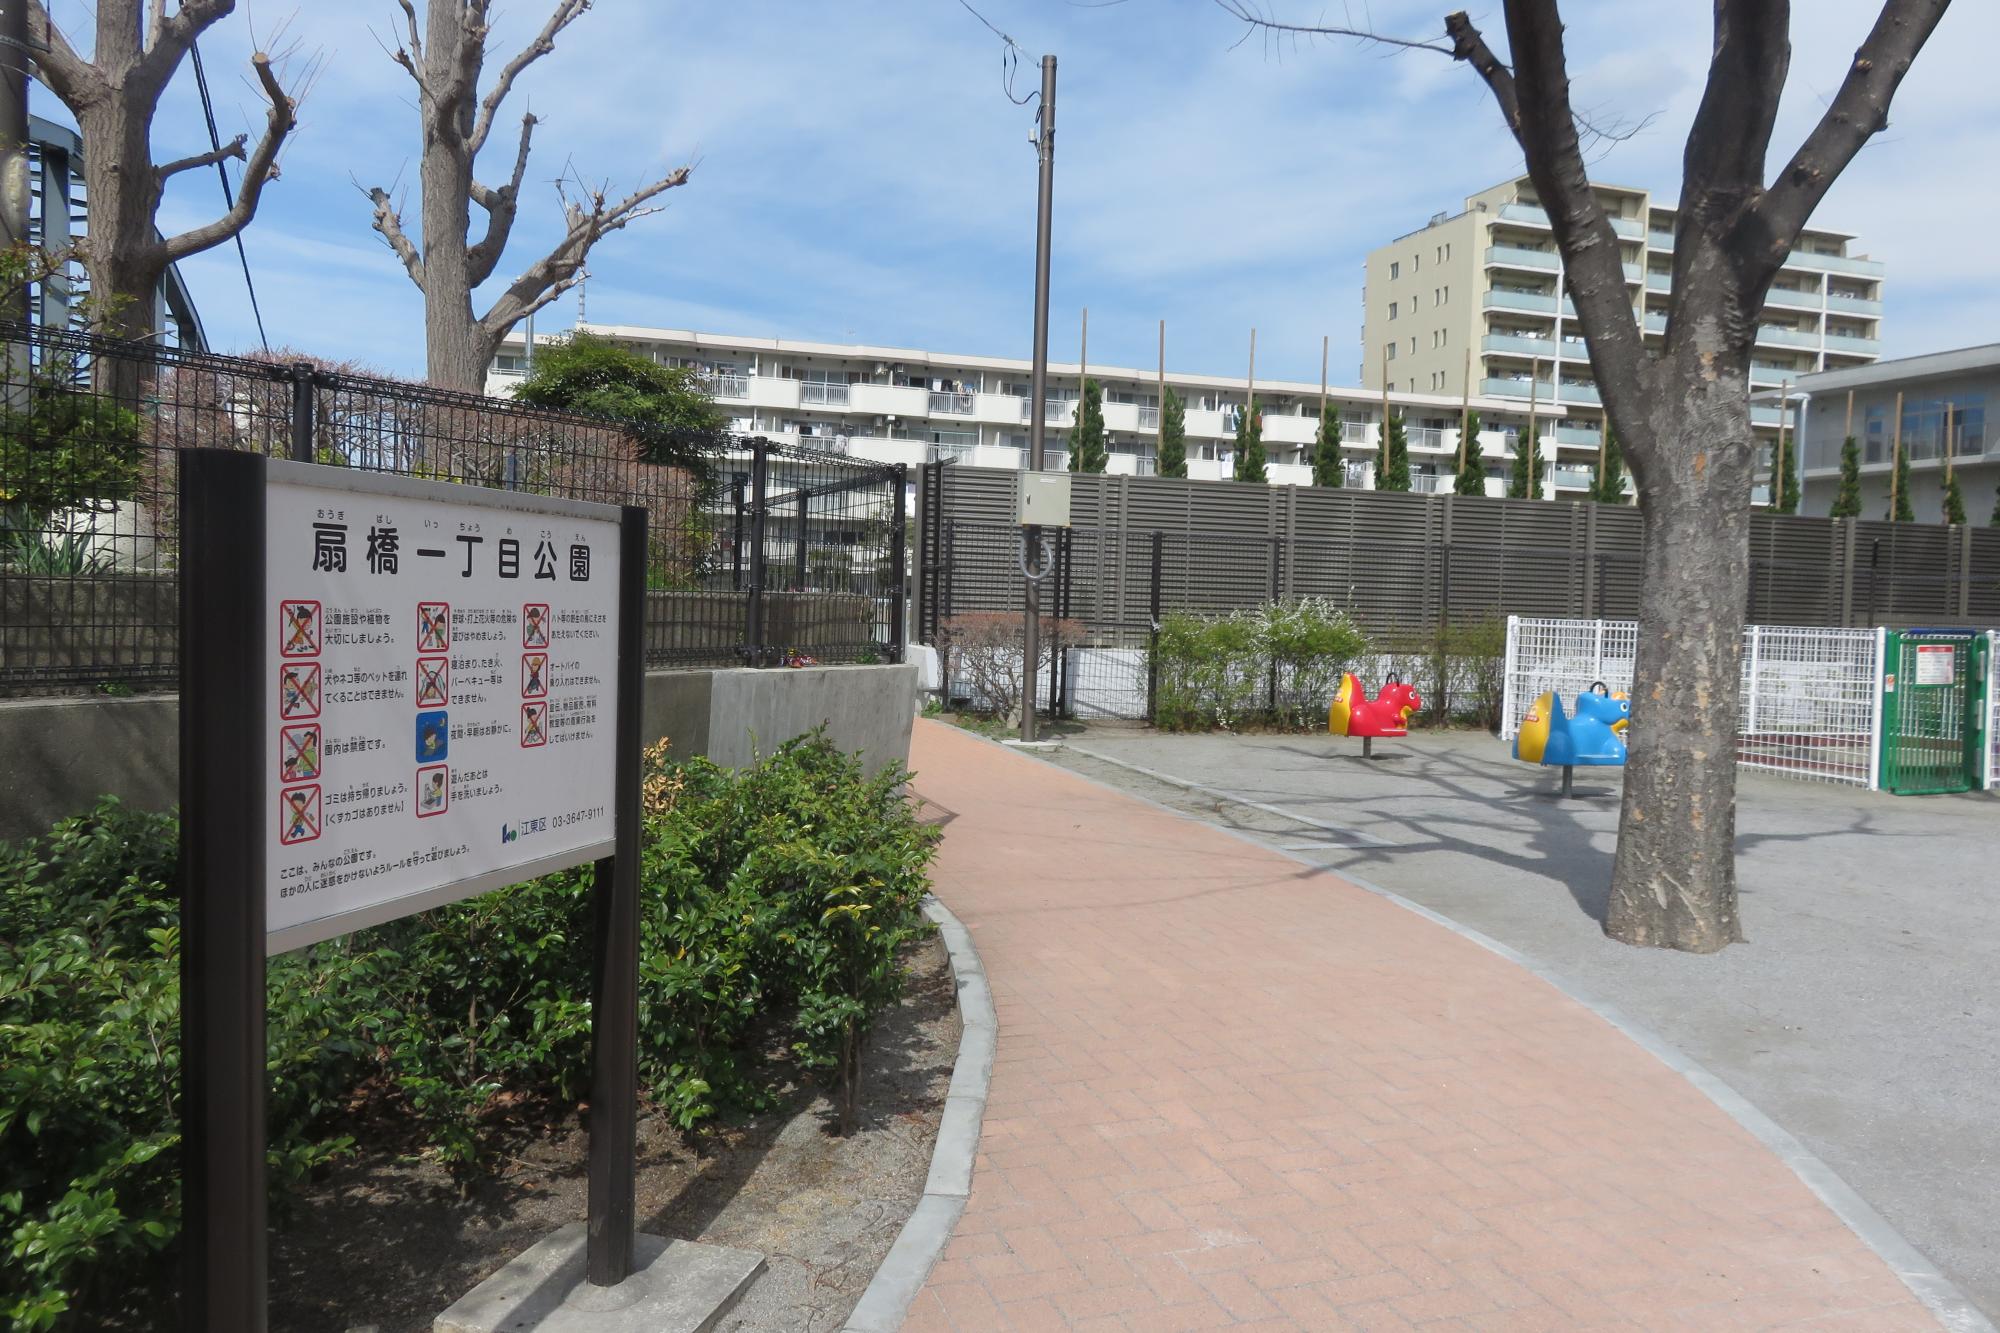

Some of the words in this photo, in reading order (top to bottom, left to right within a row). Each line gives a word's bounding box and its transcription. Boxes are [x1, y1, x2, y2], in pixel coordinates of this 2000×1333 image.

[312, 522, 591, 582] 扇橋一丁目公園
[324, 632, 394, 645] 大切にしましょう。
[324, 688, 404, 704] てくることはできません。
[450, 693, 487, 705] できません。
[521, 816, 547, 836] 江東区
[552, 805, 604, 829] 03-3647-9111
[279, 850, 377, 880] ここは、みんなの公園です。
